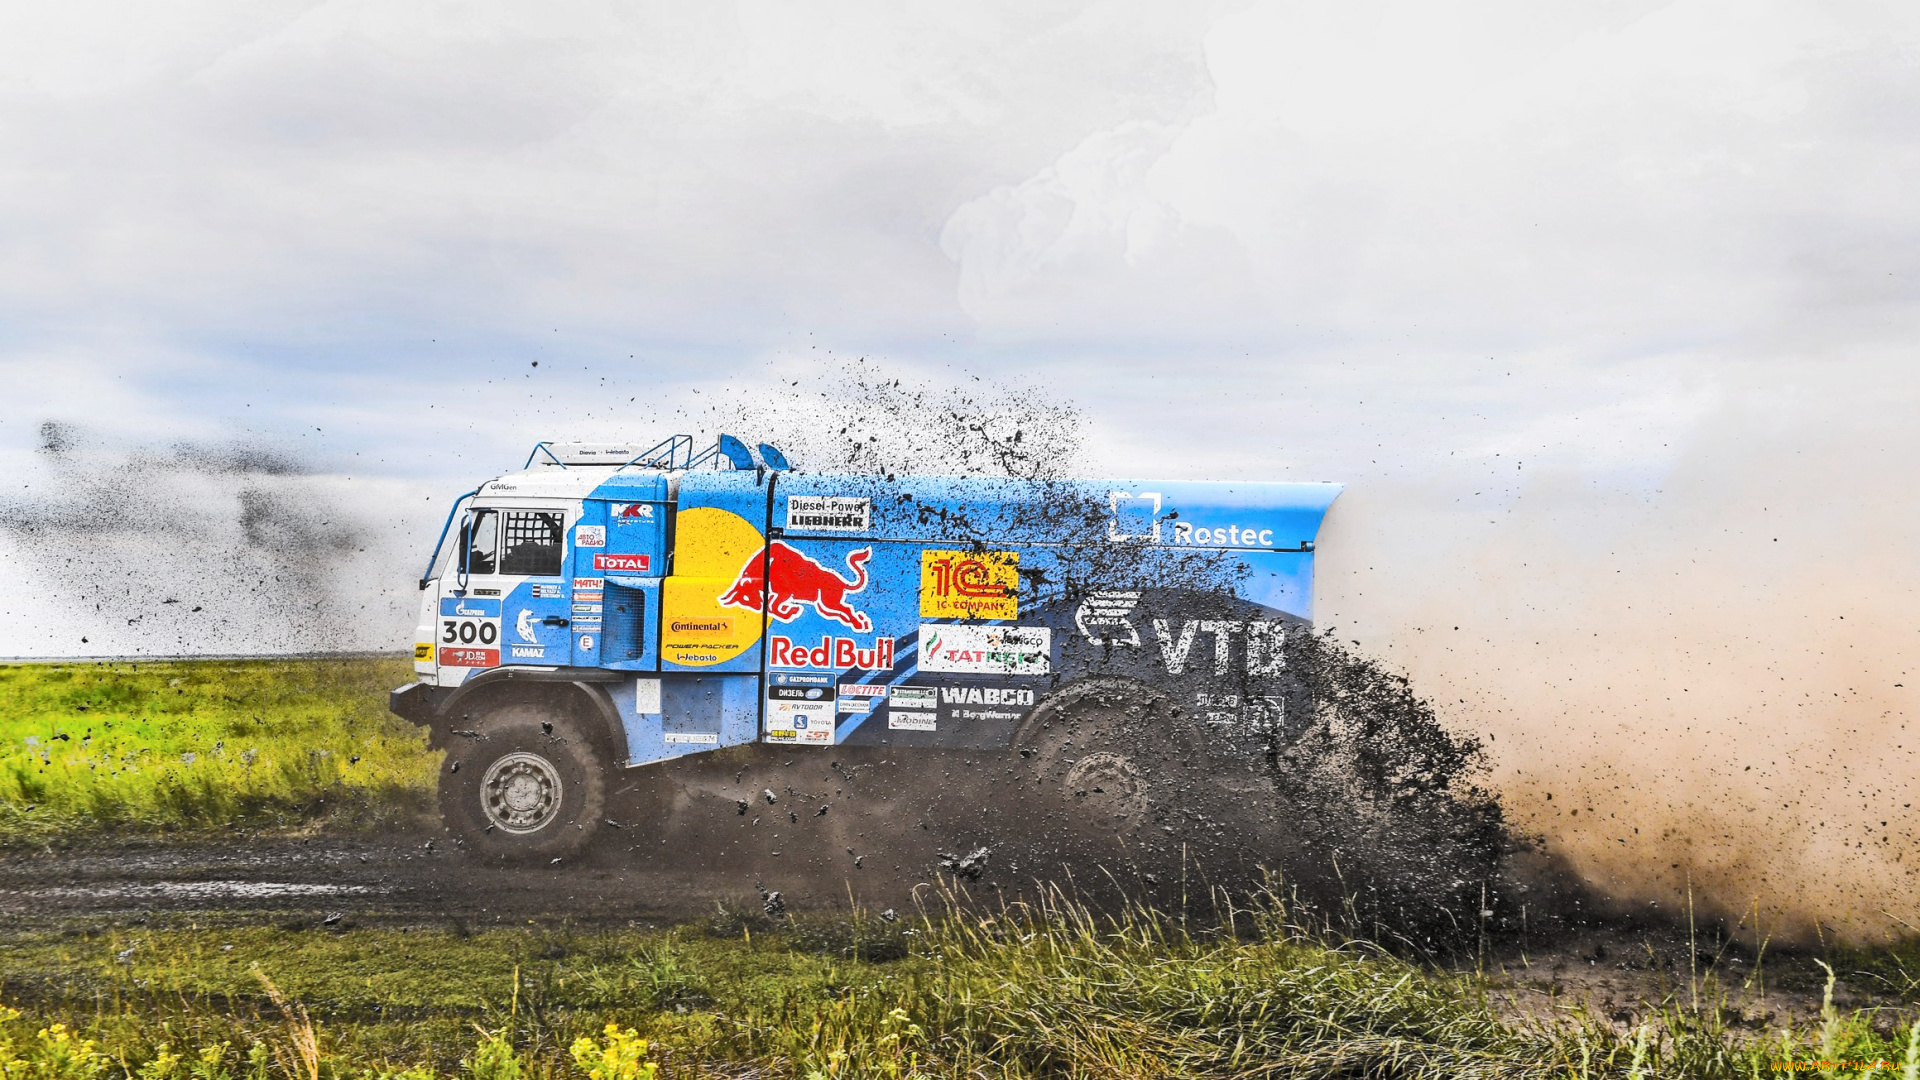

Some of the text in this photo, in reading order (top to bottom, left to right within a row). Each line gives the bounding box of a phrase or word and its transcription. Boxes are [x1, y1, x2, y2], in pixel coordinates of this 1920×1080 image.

[791, 515, 864, 527] LIEBHERR
[1174, 521, 1274, 546] Rostec
[596, 556, 647, 569] TOTAL
[952, 601, 1007, 611] COMPANY
[442, 621, 498, 645] 300
[671, 621, 721, 633] Continental
[511, 647, 545, 658] KAMAZ
[676, 653, 718, 662] Webasto
[840, 684, 886, 696] LOCTITE
[940, 687, 1035, 706] WABCO
